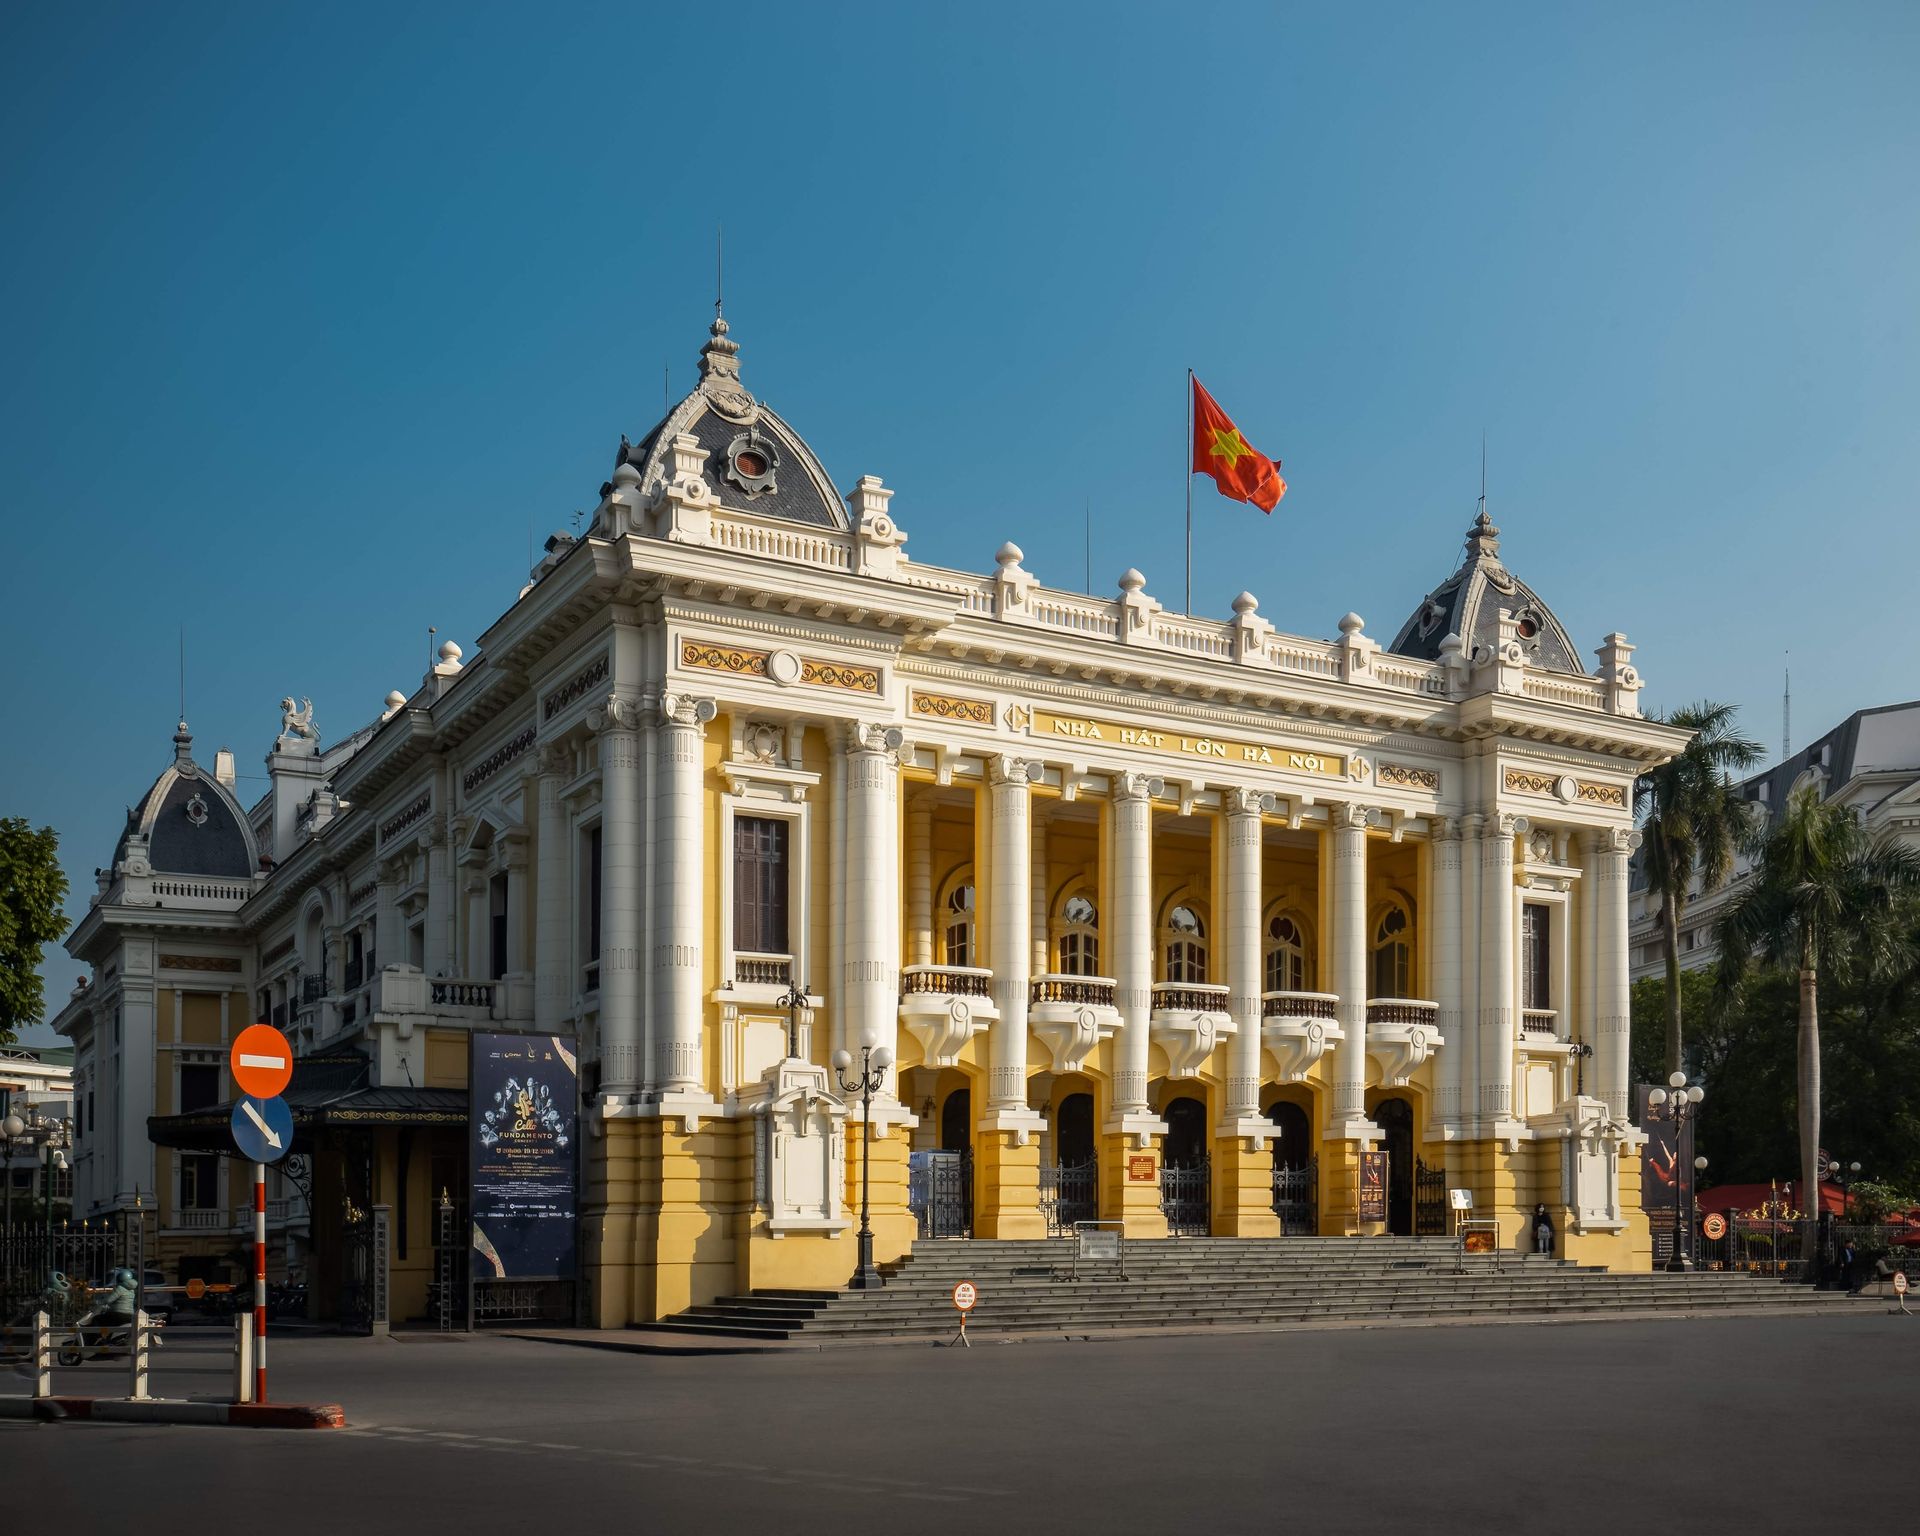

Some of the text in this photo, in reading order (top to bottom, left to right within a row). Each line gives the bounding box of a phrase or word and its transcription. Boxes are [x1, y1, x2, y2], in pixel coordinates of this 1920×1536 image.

[1053, 719, 1102, 739] NHÀ
[1120, 729, 1165, 747] HÁT
[1243, 746, 1273, 763] HÀ
[1289, 753, 1325, 772] NỘI
[515, 1119, 537, 1131] Cello
